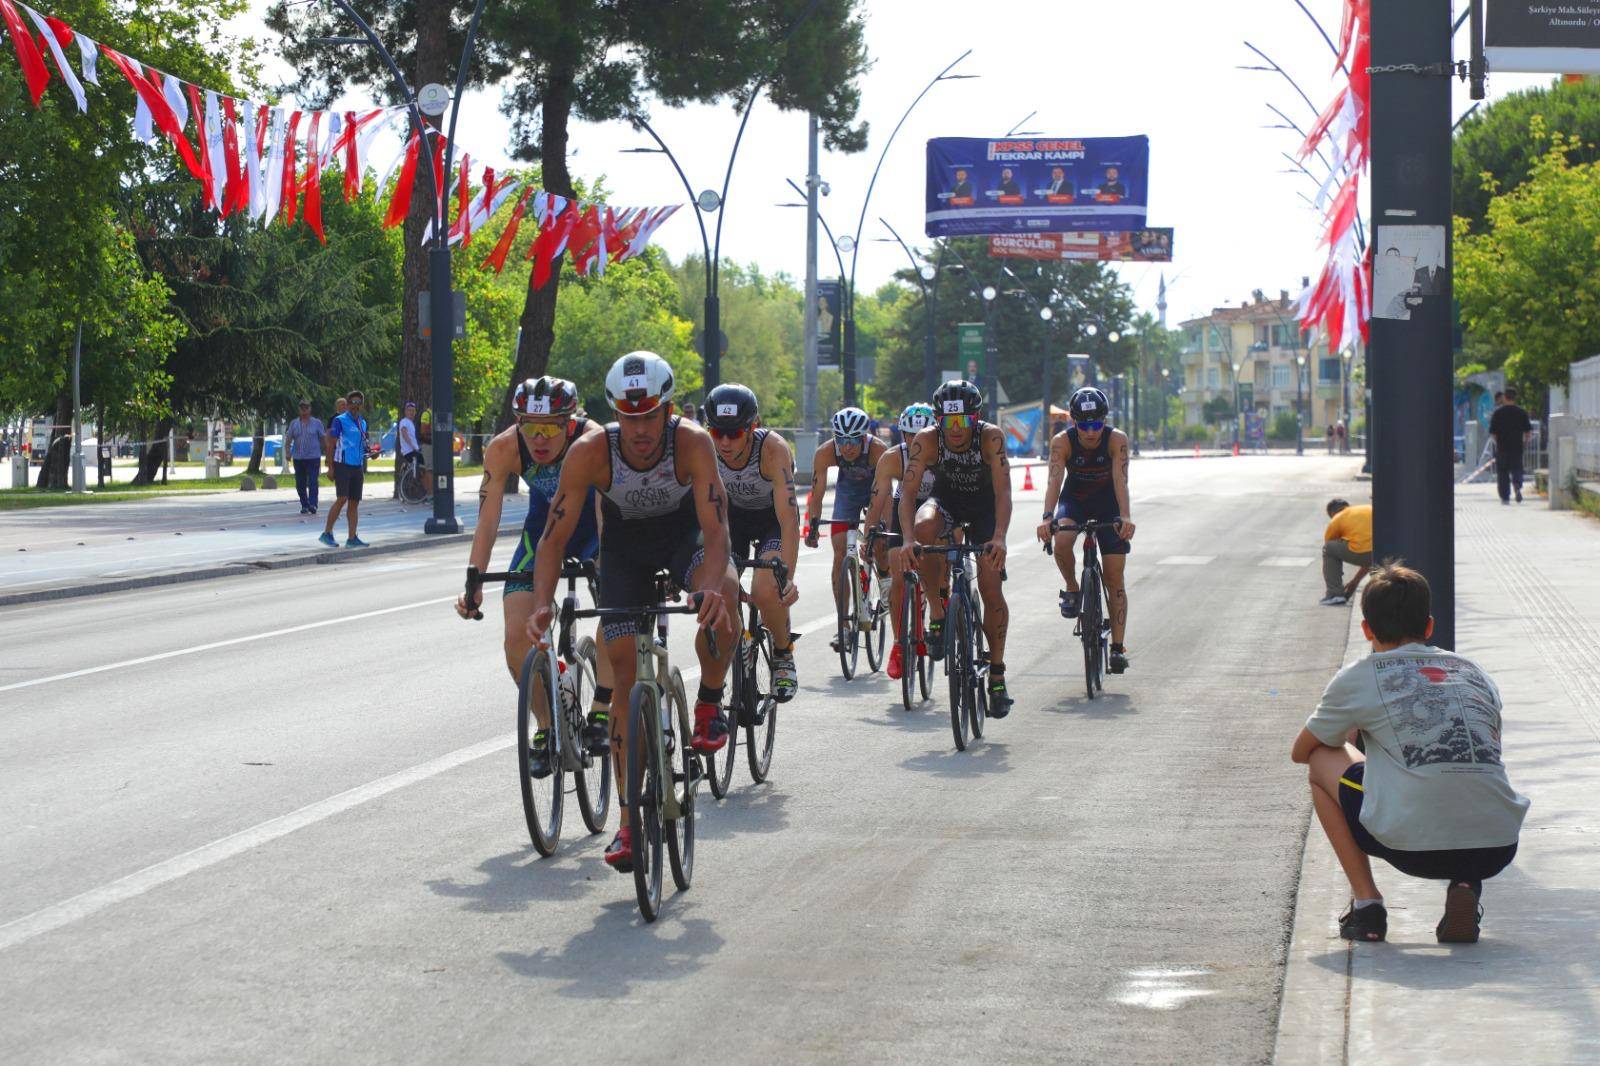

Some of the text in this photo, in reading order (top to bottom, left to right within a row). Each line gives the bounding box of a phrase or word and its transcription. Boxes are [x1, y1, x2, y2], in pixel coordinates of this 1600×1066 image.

[995, 141, 1034, 152] KPSS
[1036, 140, 1086, 151] GENEL
[995, 151, 1042, 161] TEKRAR
[1044, 150, 1085, 160] KAMPI
[628, 378, 639, 388] 41
[533, 404, 544, 413] 27
[722, 407, 732, 415] 42
[947, 402, 959, 413] 25
